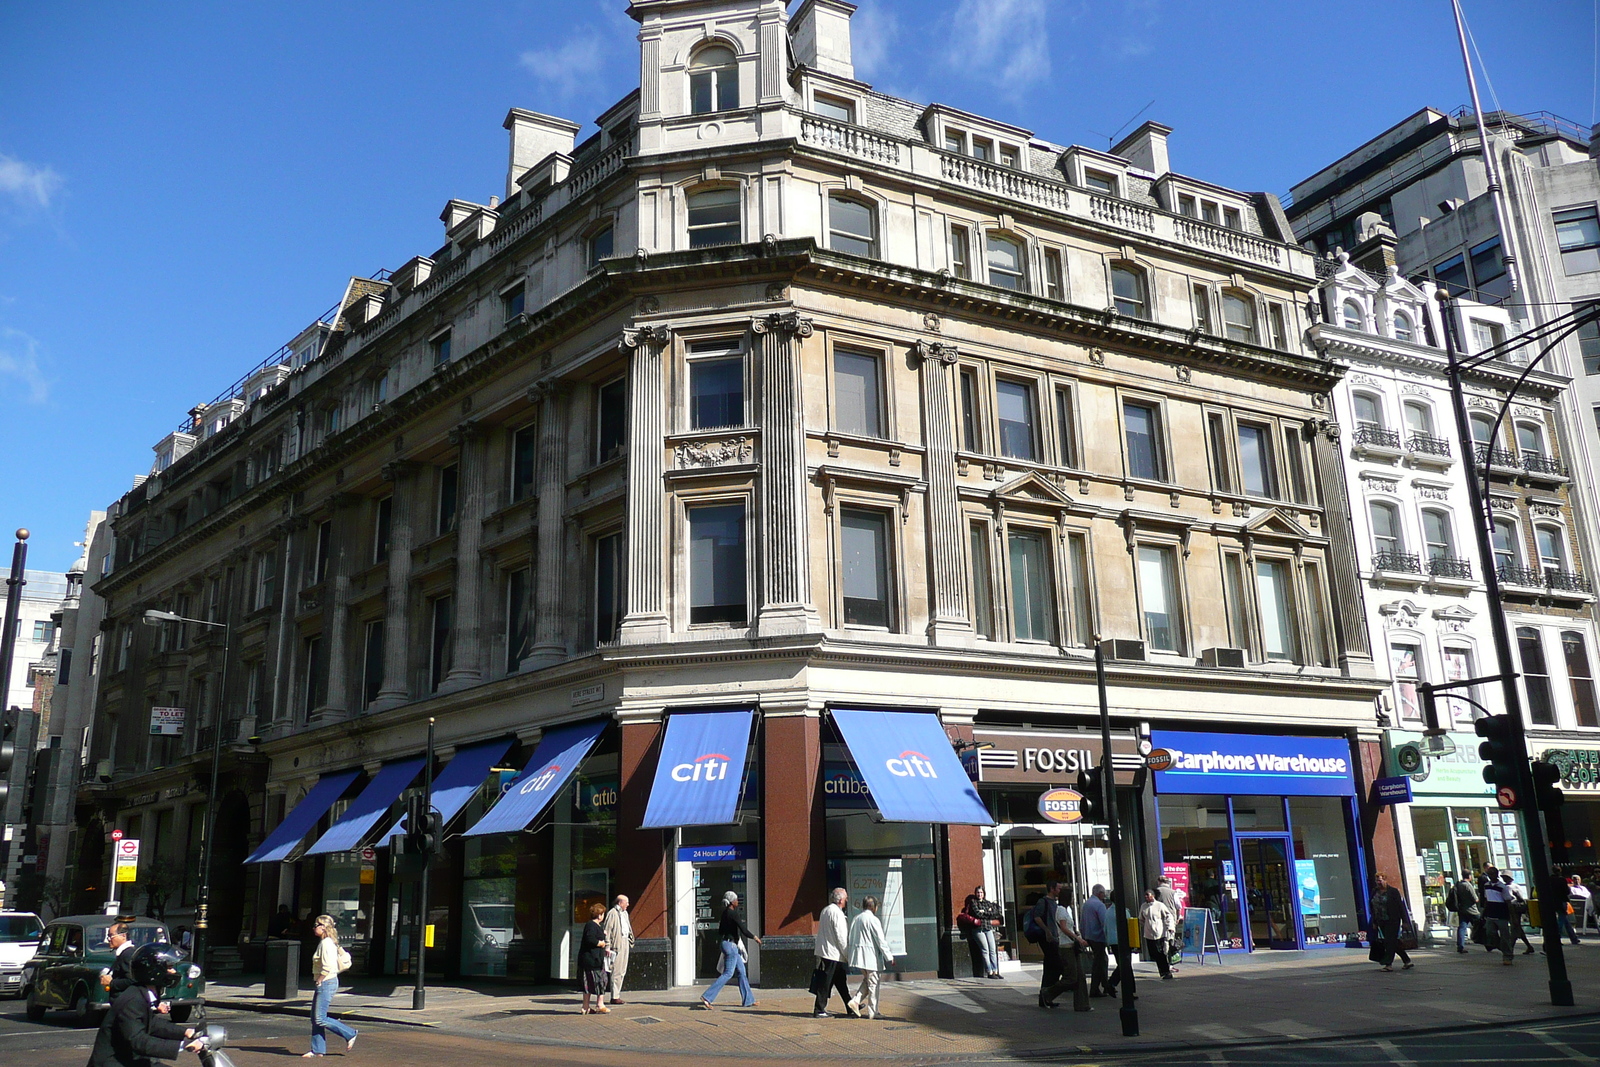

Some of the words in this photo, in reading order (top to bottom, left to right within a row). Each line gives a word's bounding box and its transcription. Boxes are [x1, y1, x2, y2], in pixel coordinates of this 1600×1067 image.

[1024, 747, 1095, 771] FOSSIL
[1147, 756, 1170, 764] FOSSIL
[1175, 750, 1255, 772] Carphone
[1255, 753, 1347, 773] Warehouse
[671, 756, 729, 782] citi
[886, 754, 938, 779] citi
[1570, 768, 1600, 783] COF
[520, 770, 556, 795] citi
[1381, 783, 1406, 792] Carphone
[1379, 789, 1407, 797] Warehouse
[1044, 800, 1080, 811] FOSSI
[693, 850, 701, 858] 24
[718, 849, 741, 857] Banking
[853, 878, 883, 889] 6.27%
